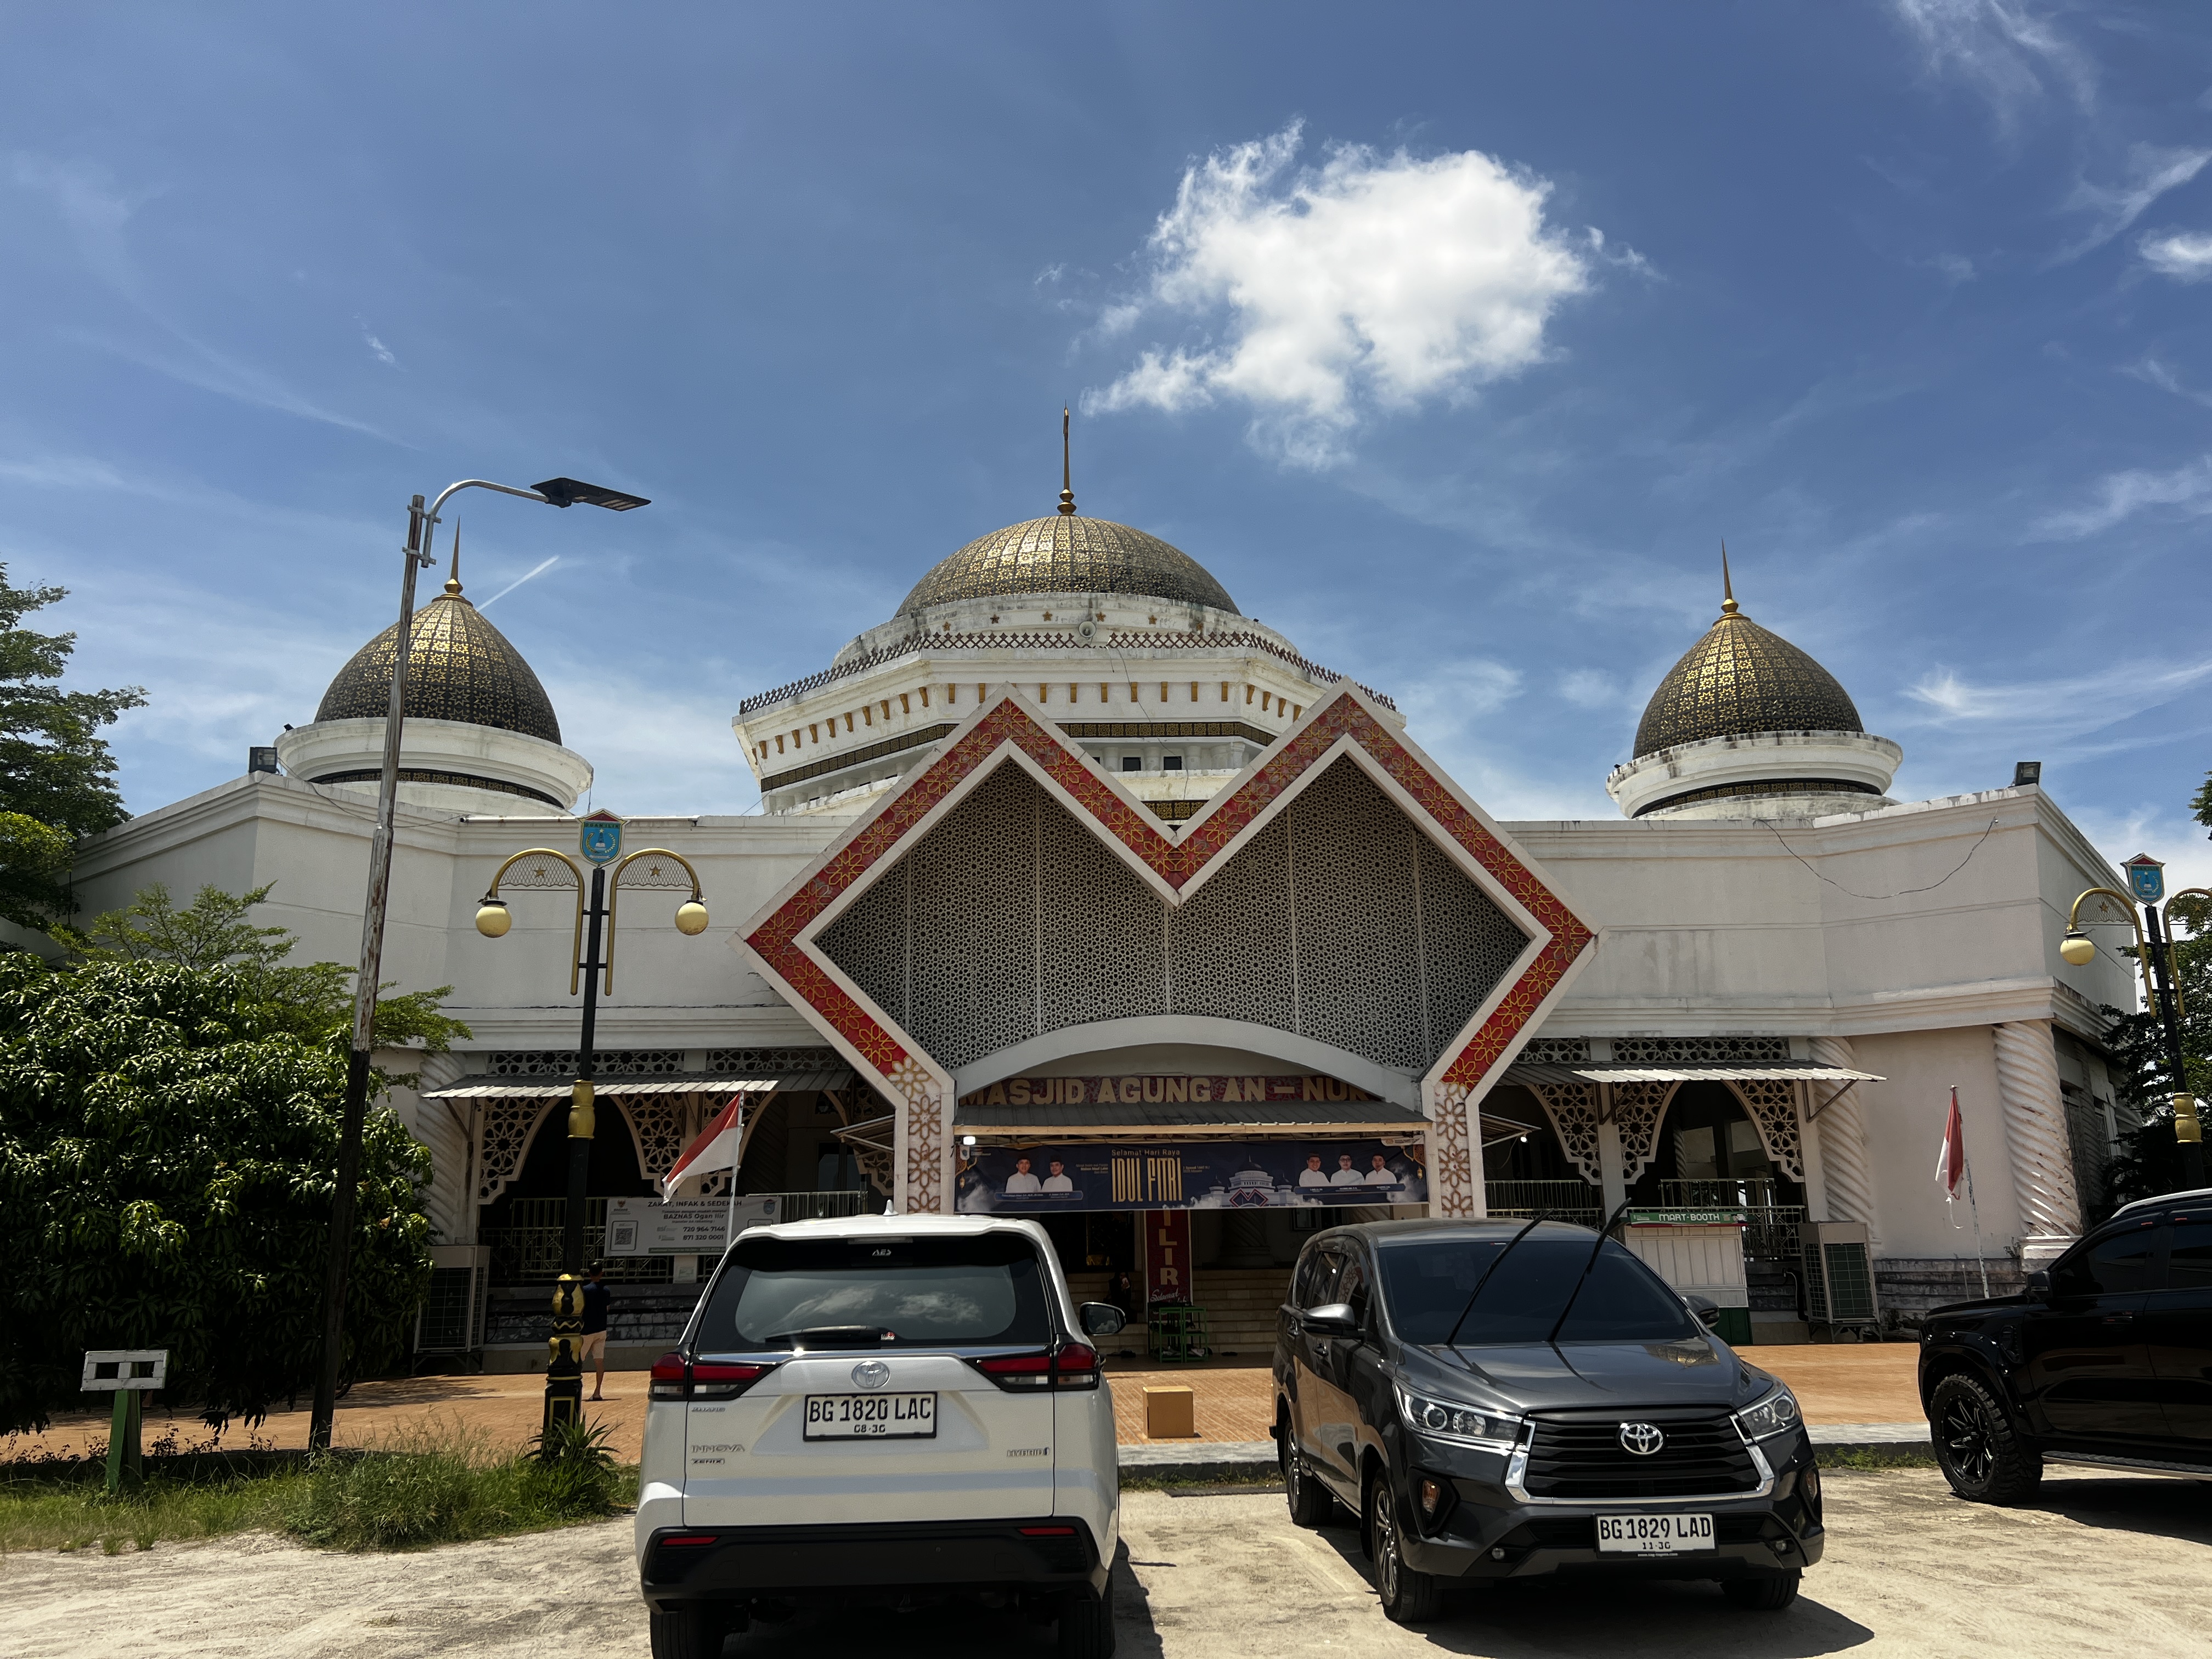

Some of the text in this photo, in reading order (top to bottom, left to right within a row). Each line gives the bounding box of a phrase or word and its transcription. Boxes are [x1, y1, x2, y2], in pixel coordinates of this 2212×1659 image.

[1097, 1077, 1210, 1103] AGUNG
[1111, 1157, 1183, 1203] IDUL FITRI
[1150, 1288, 1181, 1302] Selamat
[809, 1397, 932, 1423] BG 1820 LAC
[691, 1444, 746, 1453] INNOVA
[1006, 1448, 1044, 1457] HYBRID
[1599, 1517, 1712, 1540] BG 1829 LAD
